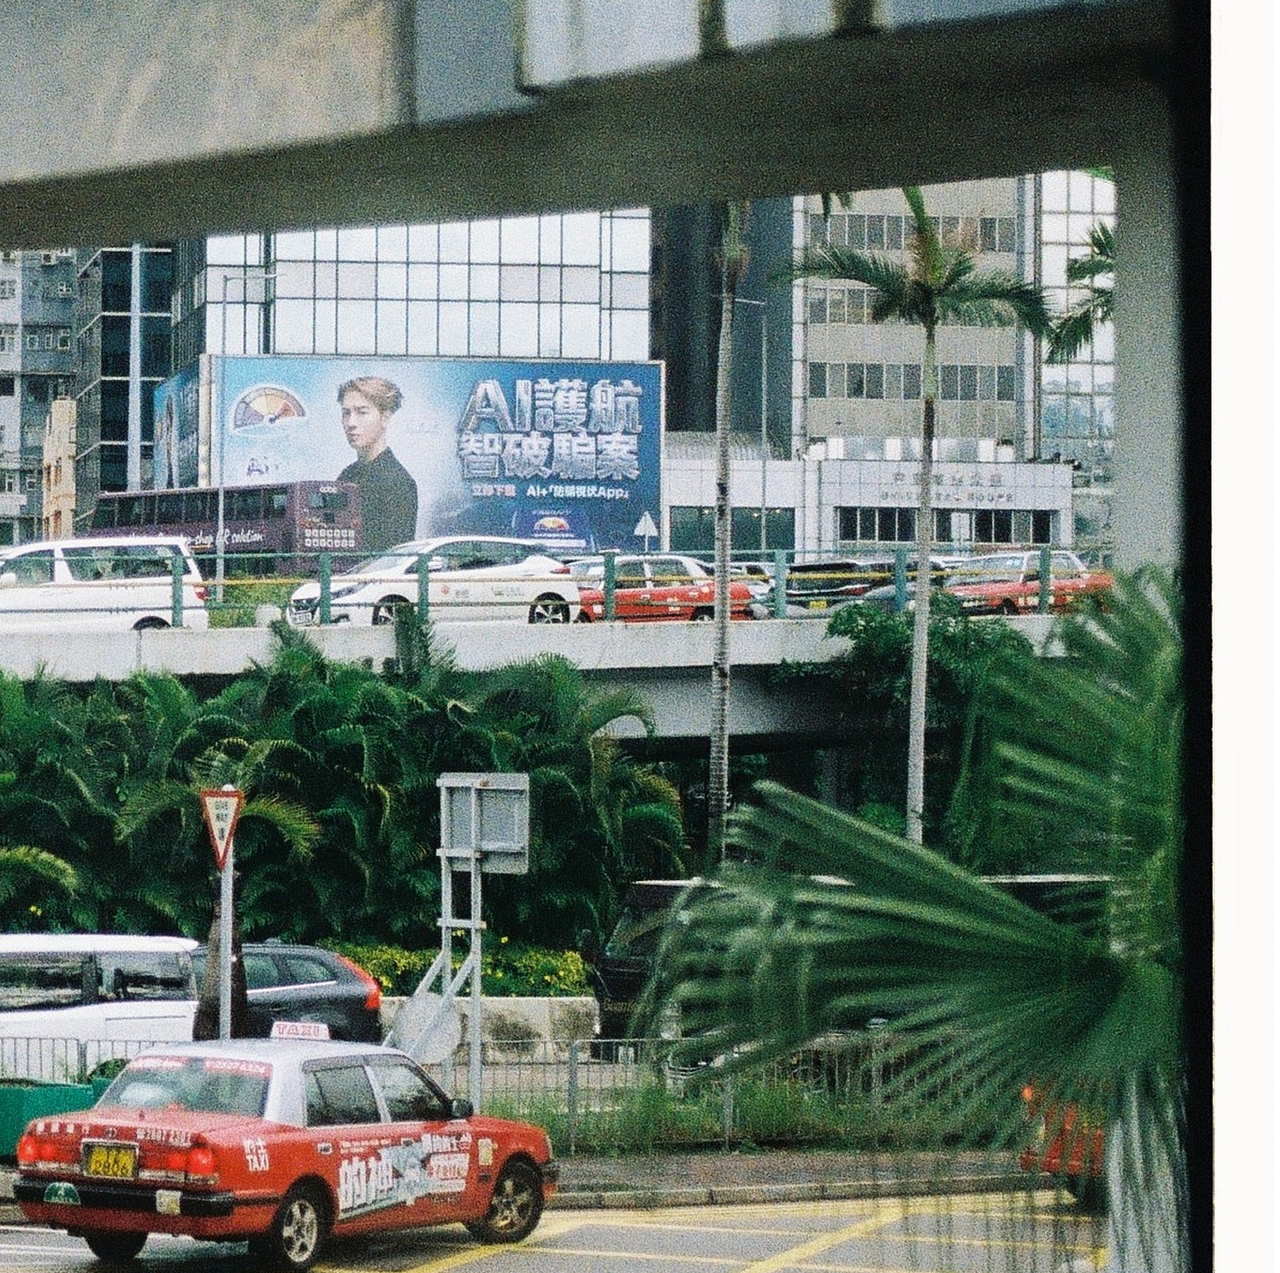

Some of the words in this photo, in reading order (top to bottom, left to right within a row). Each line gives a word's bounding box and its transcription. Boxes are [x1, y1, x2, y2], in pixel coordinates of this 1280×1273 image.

[459, 379, 643, 433] AI護航
[458, 429, 641, 480] 智破騙案
[275, 1023, 320, 1038] TAXI
[246, 1153, 270, 1172] TAXI
